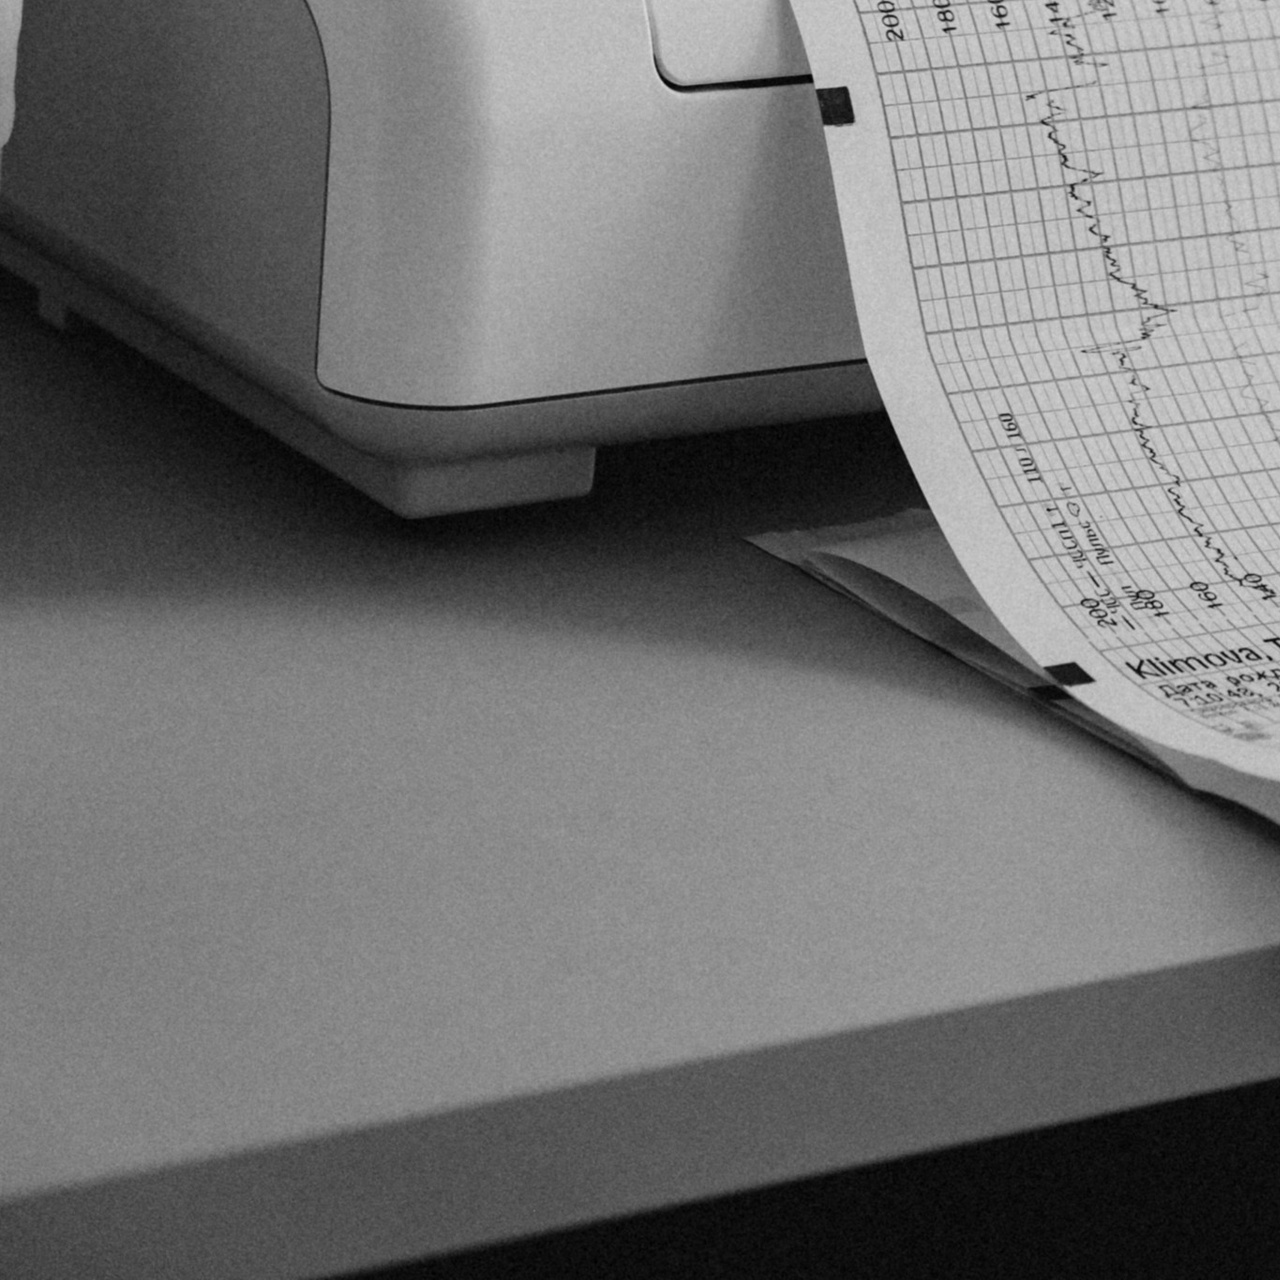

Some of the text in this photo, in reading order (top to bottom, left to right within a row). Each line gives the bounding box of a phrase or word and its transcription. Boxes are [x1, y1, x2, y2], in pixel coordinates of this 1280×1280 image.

[877, 0, 905, 41] 200
[998, 412, 1023, 439] 160
[1190, 581, 1224, 610] 160
[1243, 573, 1278, 601] 140
[1080, 597, 1118, 629] 200
[1135, 588, 1170, 618] 180
[1125, 645, 1273, 680] Klimova,
[1158, 679, 1216, 700] Дата
